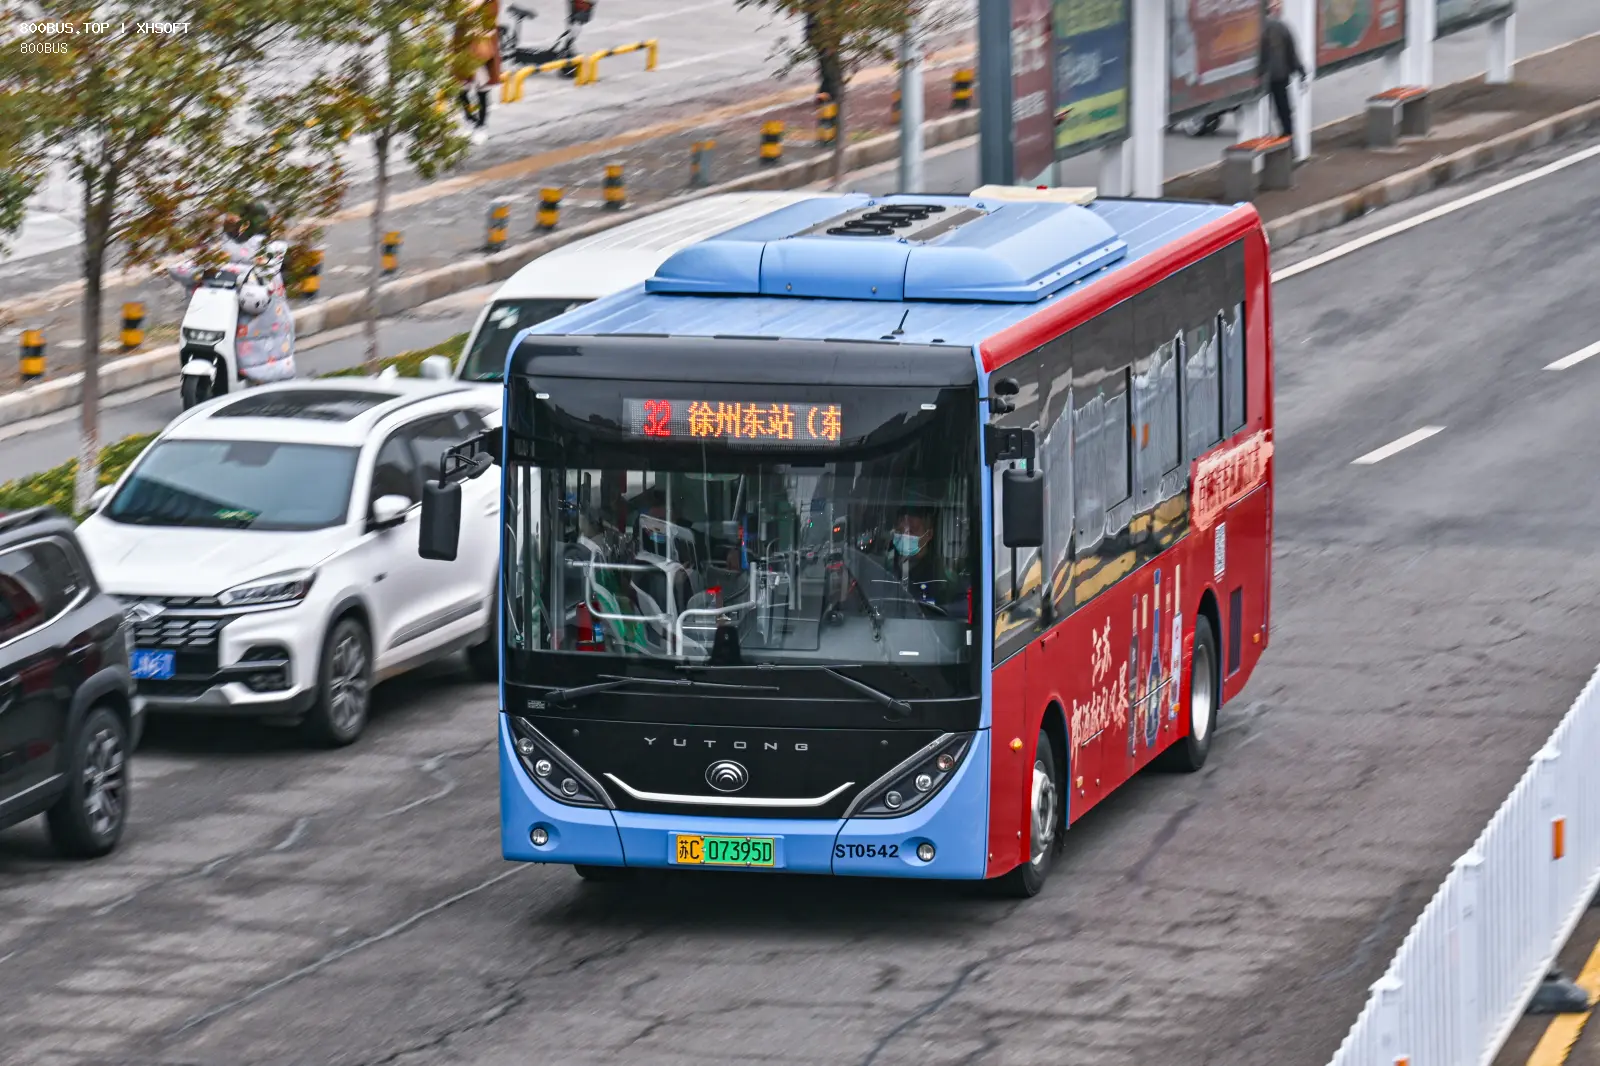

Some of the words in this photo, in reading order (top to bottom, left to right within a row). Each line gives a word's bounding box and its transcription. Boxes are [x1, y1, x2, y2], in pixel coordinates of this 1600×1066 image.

[643, 399, 672, 438] 32
[643, 737, 809, 751] YUTONG
[835, 844, 899, 858] ST0542
